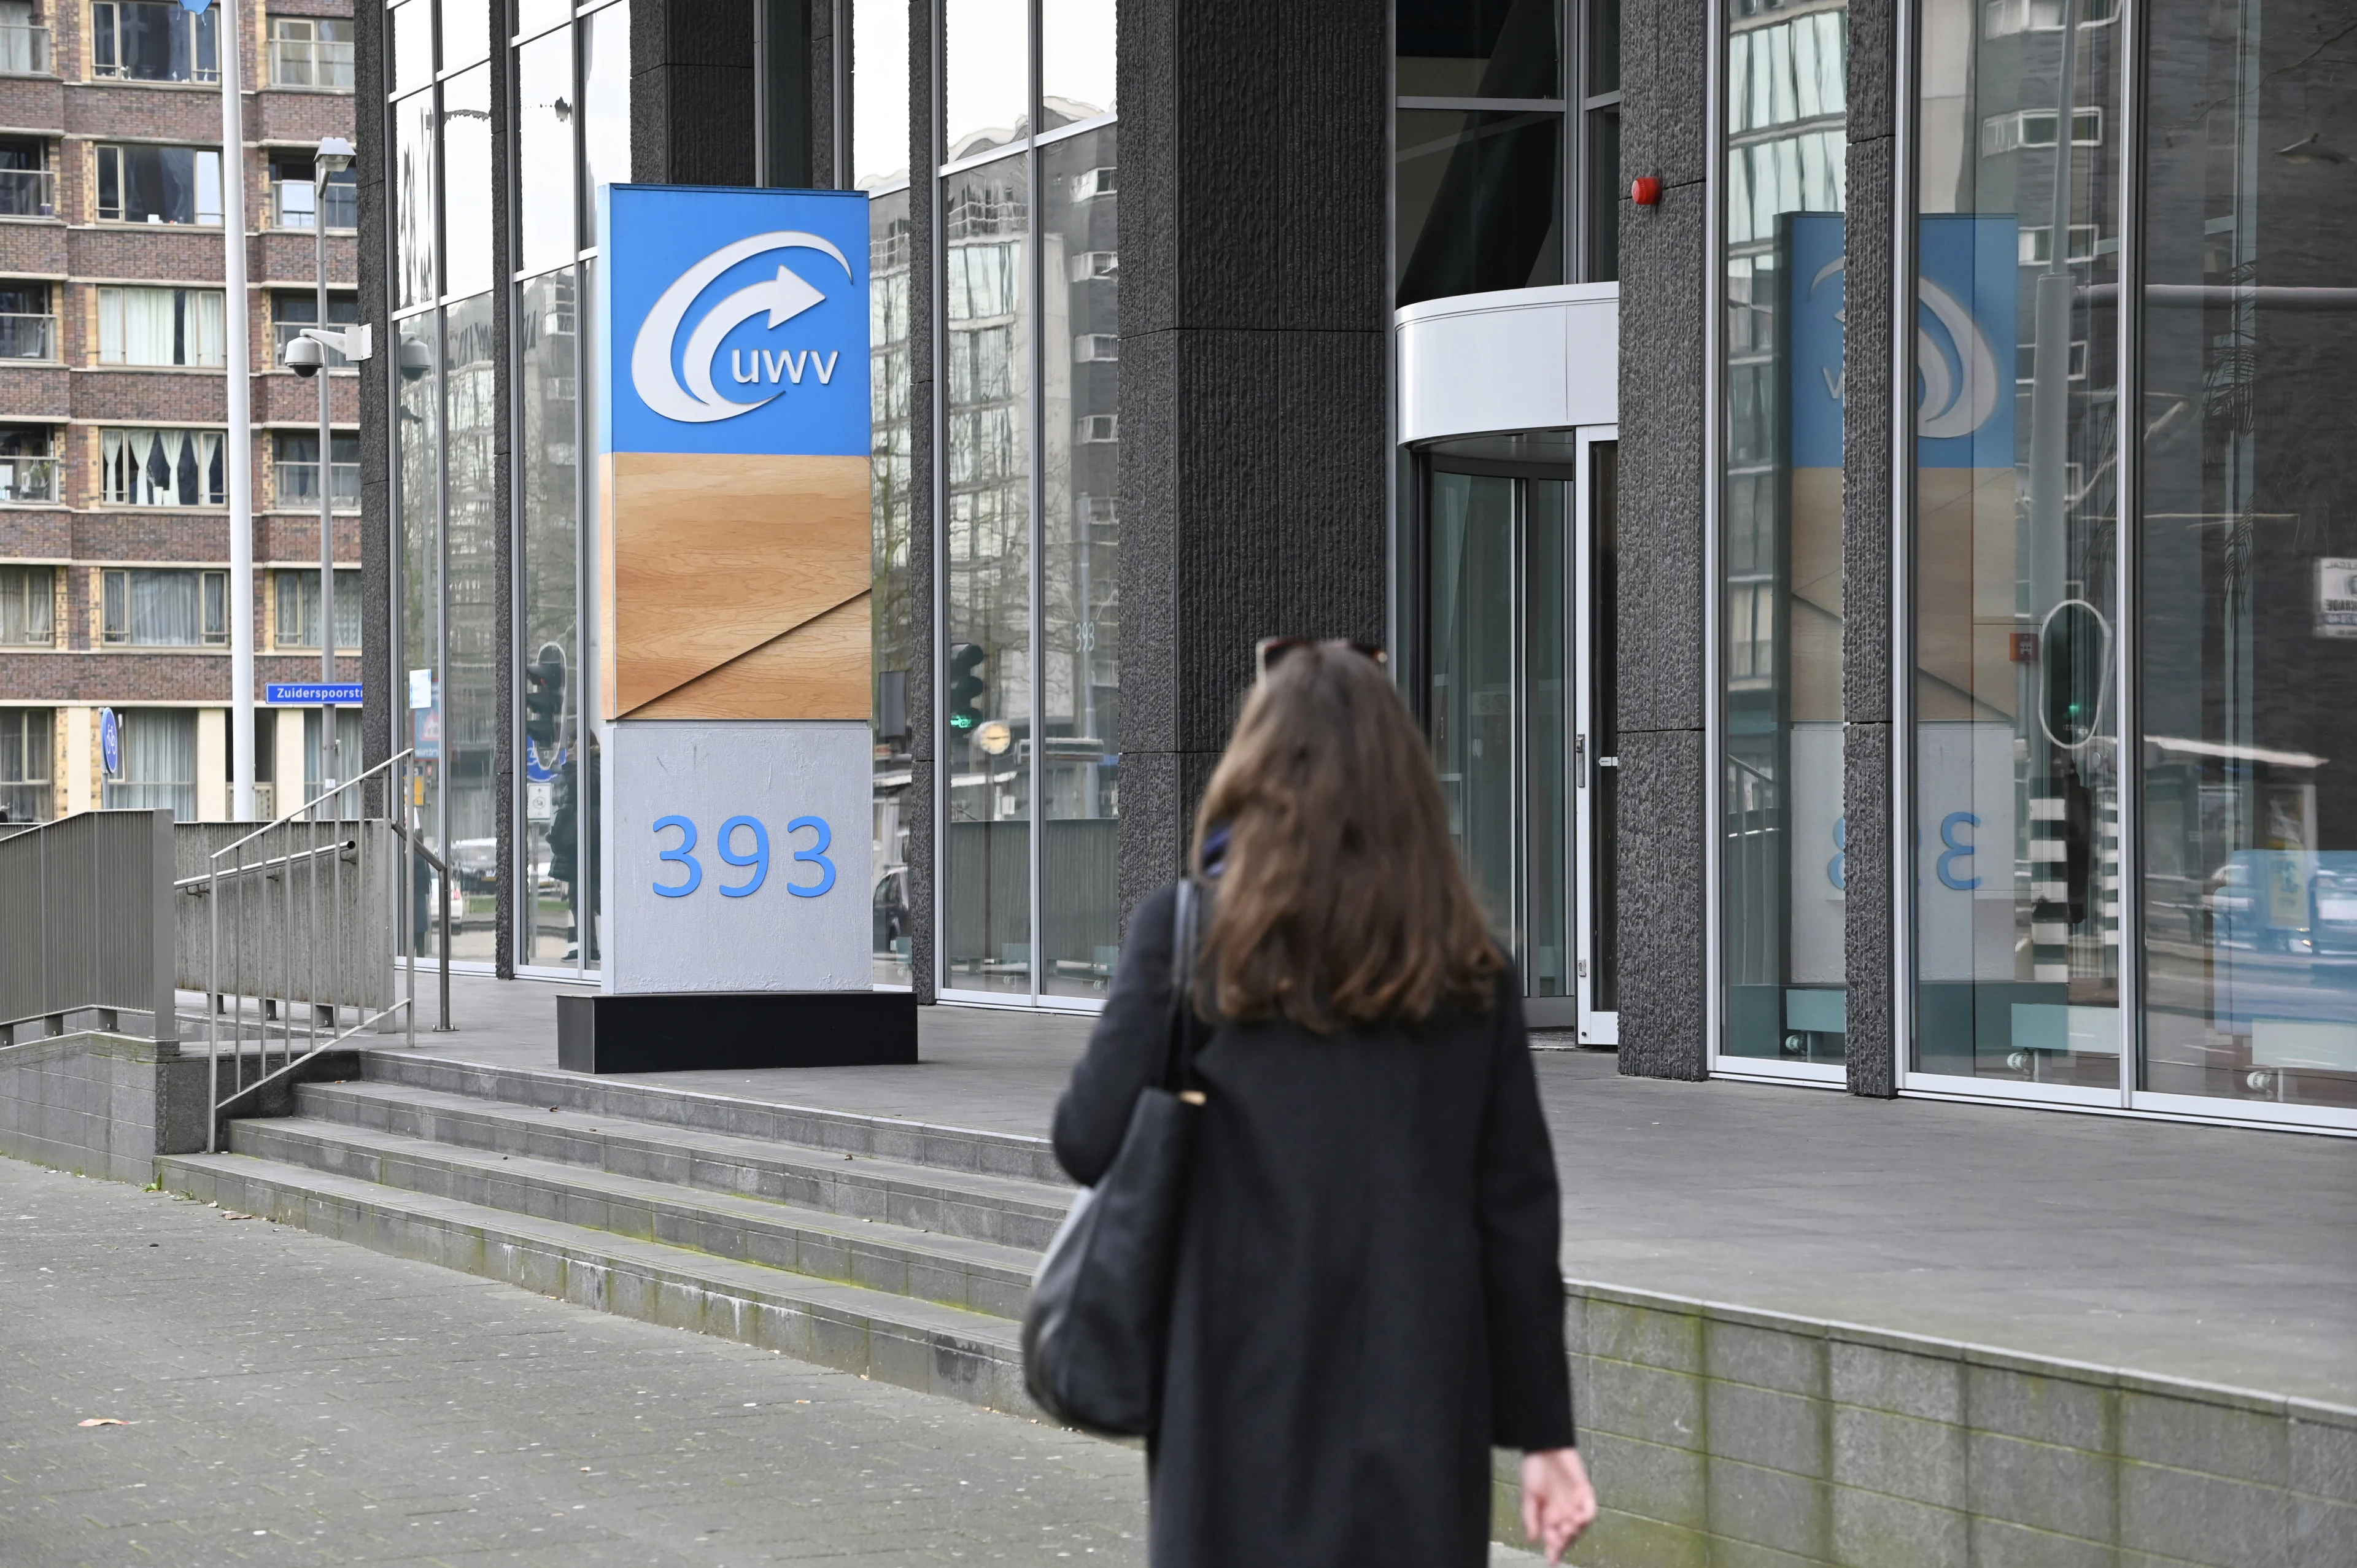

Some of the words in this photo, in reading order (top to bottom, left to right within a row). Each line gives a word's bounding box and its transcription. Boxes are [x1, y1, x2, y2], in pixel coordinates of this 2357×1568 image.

[732, 349, 839, 385] uwv
[1076, 621, 1095, 653] 393
[652, 814, 836, 897] 393
